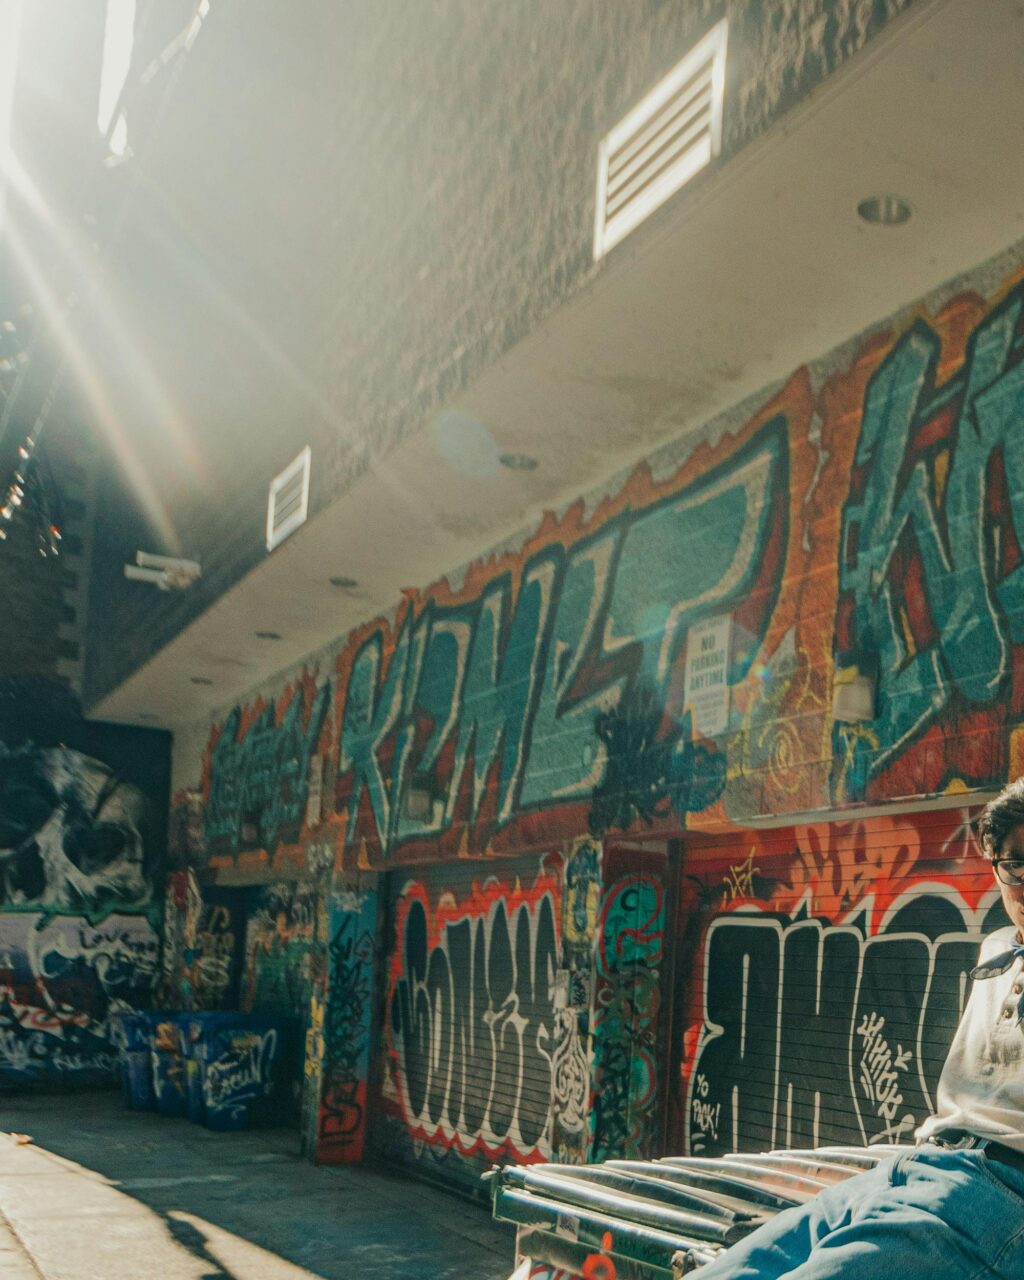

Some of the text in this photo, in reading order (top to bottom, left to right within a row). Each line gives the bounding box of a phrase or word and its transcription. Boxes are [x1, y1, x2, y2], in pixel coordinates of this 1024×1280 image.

[701, 635, 716, 650] NO
[690, 649, 726, 671] PARKING
[690, 668, 725, 691] ANYTIME
